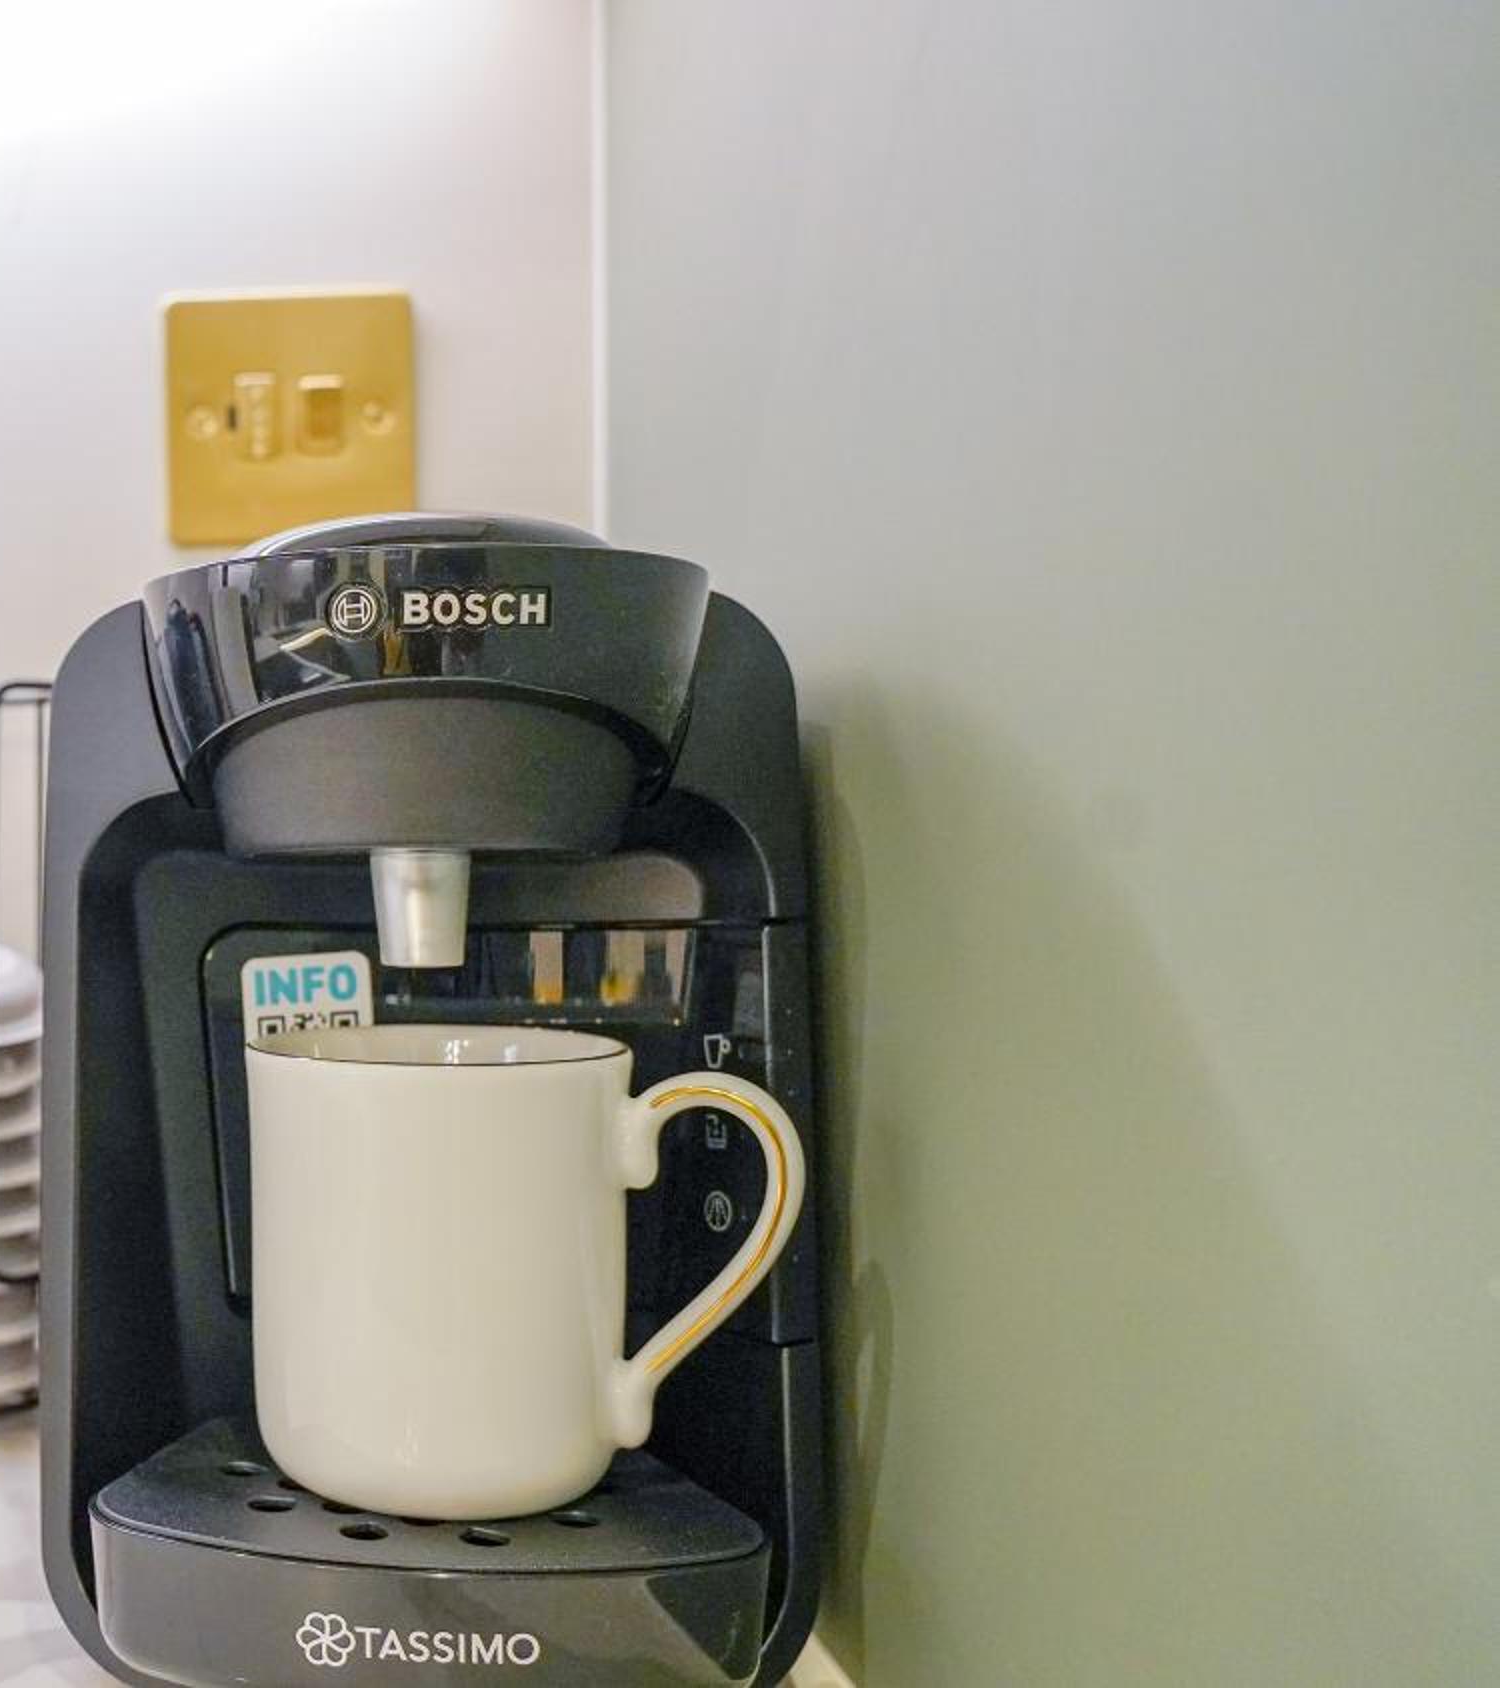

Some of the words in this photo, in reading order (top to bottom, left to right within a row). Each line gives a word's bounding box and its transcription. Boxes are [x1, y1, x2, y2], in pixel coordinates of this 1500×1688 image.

[402, 592, 547, 626] BOSCH
[253, 963, 358, 1007] INFO
[354, 1627, 540, 1665] TASSIMO
